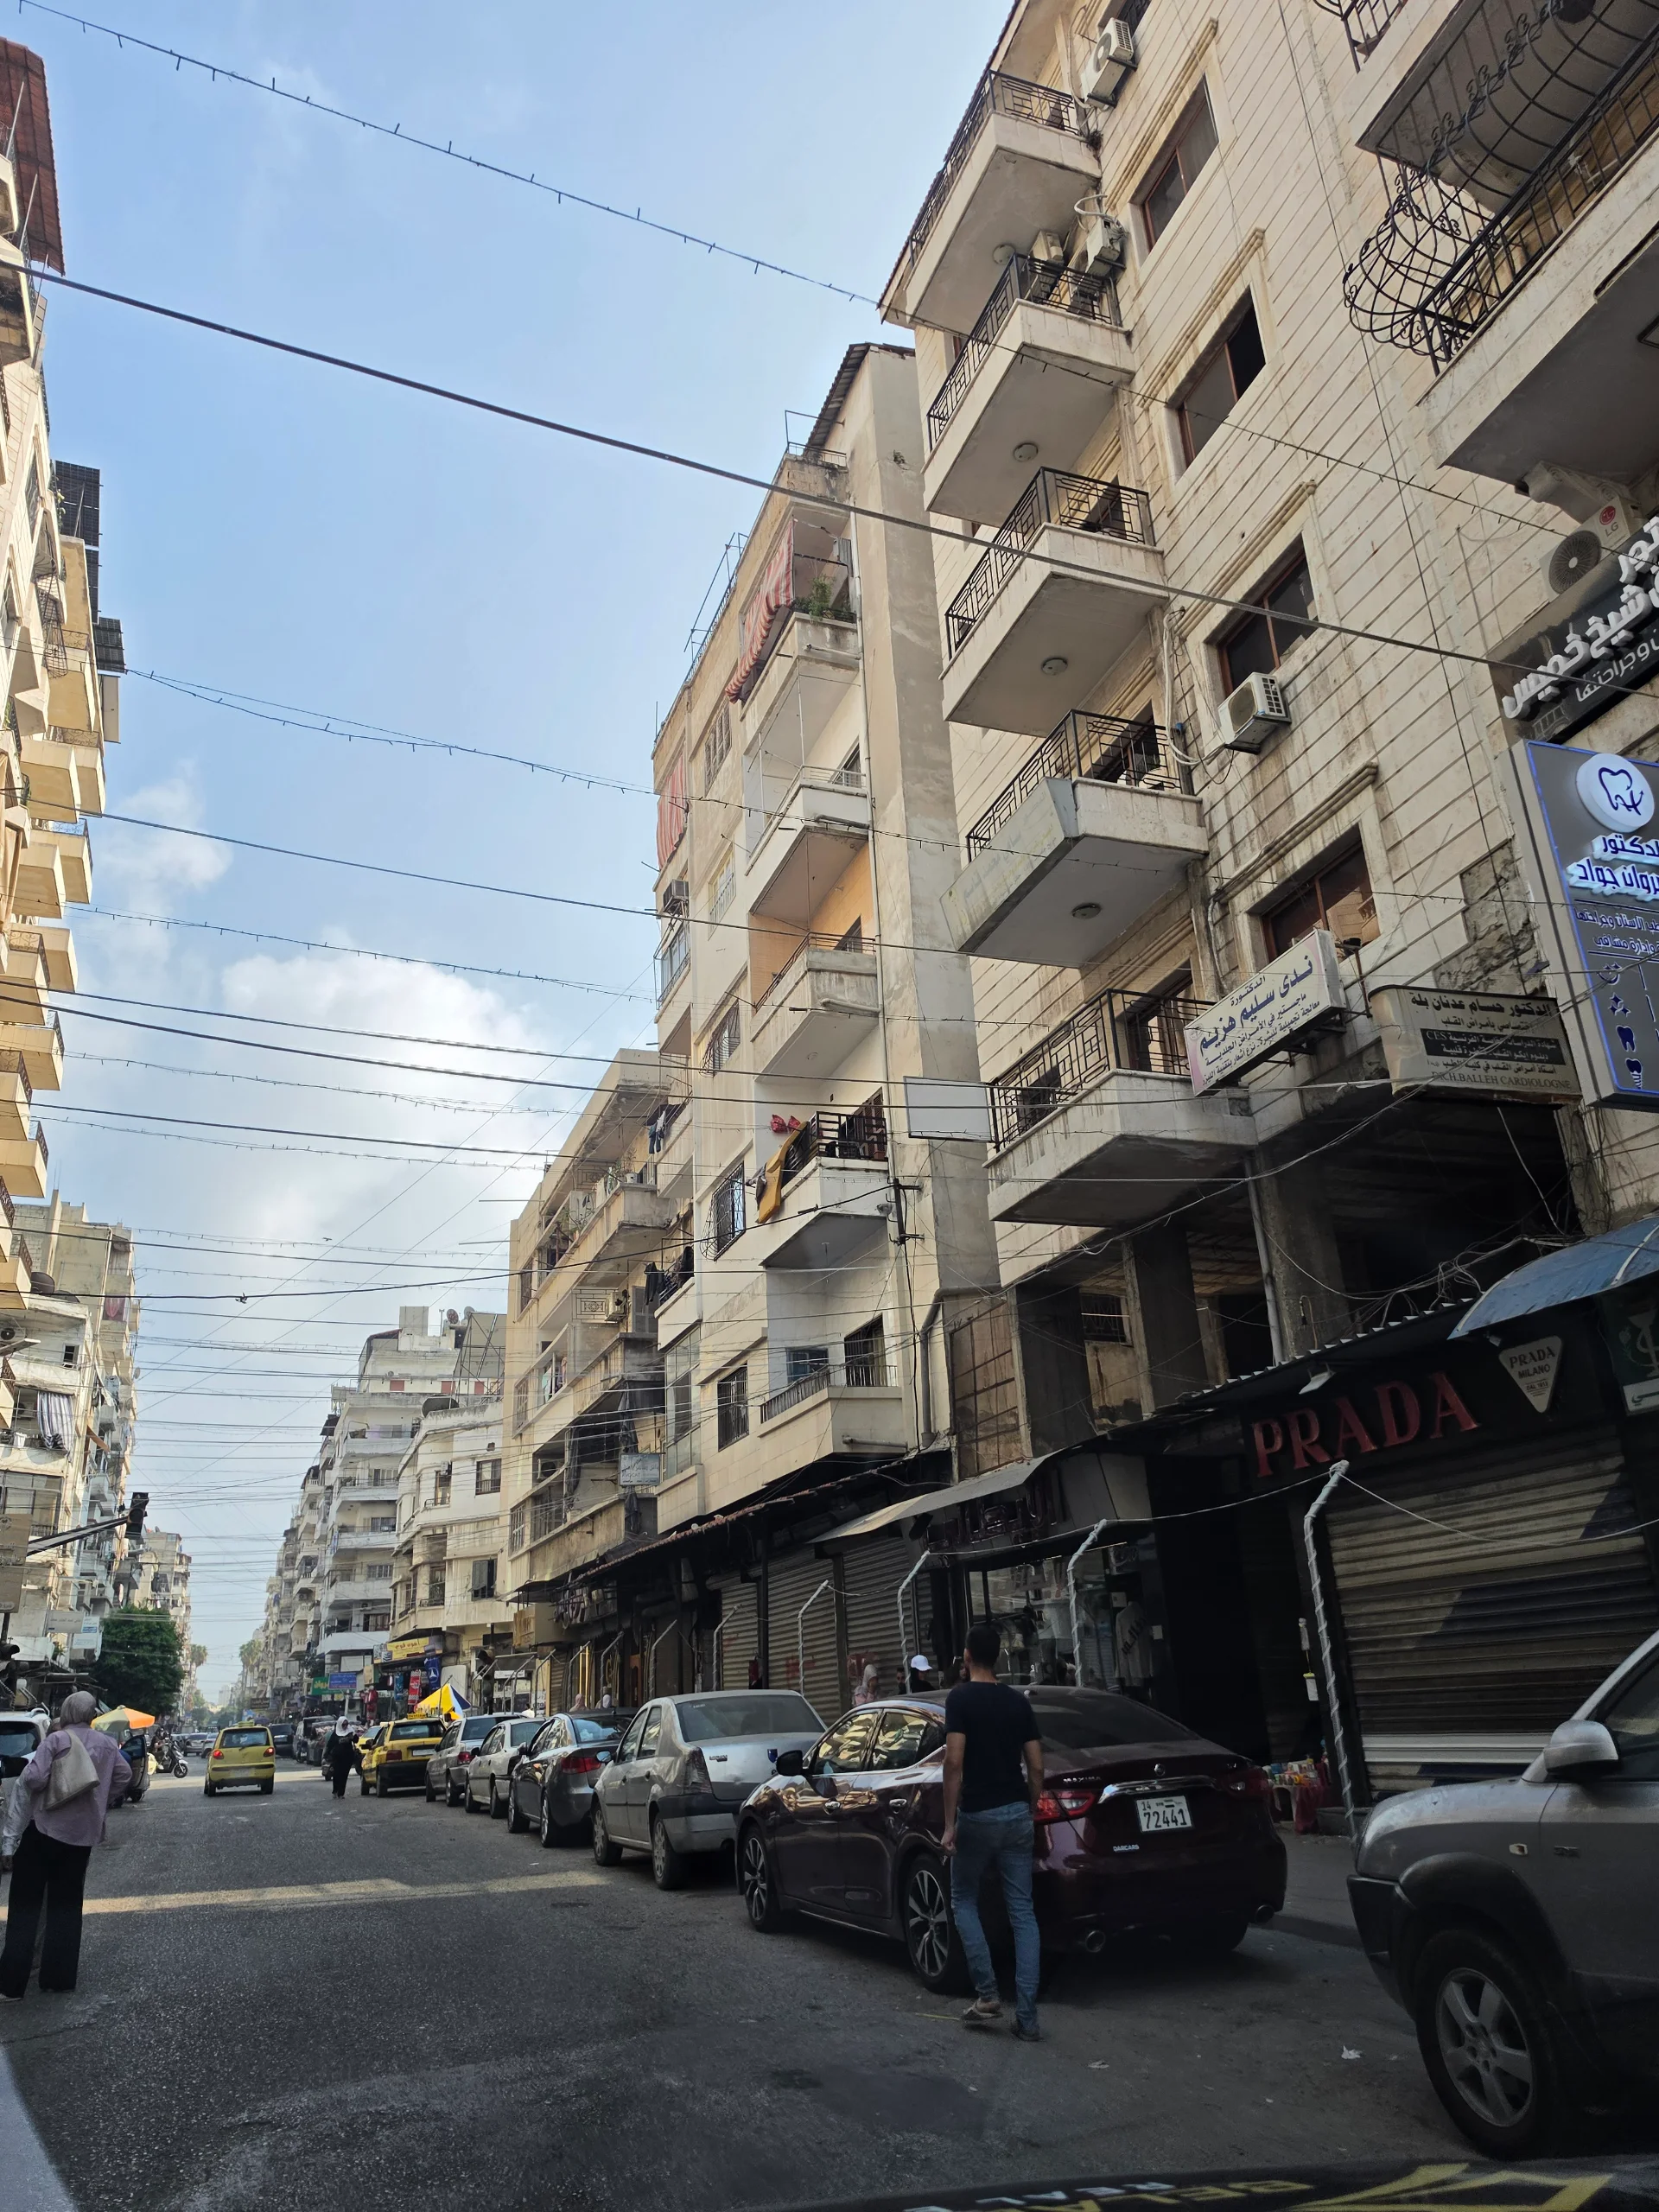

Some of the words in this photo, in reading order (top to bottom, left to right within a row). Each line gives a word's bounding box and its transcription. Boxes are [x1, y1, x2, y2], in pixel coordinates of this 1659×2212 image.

[1605, 522, 1619, 537] LG
[1576, 858, 1621, 890] جواد
[1279, 954, 1313, 999] ندى
[1230, 975, 1266, 1007] الدكتورة
[1240, 988, 1275, 1029] سليم
[1276, 993, 1306, 1020] ماجستير
[1432, 995, 1465, 1012] عدنان
[1468, 998, 1505, 1015] حسام
[1509, 1002, 1553, 1018] الدكتور
[1267, 1012, 1276, 1029] في
[1426, 1030, 1447, 1041] CES
[1205, 1039, 1237, 1067] الجلدية
[1509, 1345, 1556, 1370] PRADA
[1518, 1363, 1551, 1380] MILANO
[1251, 1370, 1481, 1478] PRADA
[1141, 1800, 1152, 1811] 14
[1143, 1808, 1187, 1829] 72441
